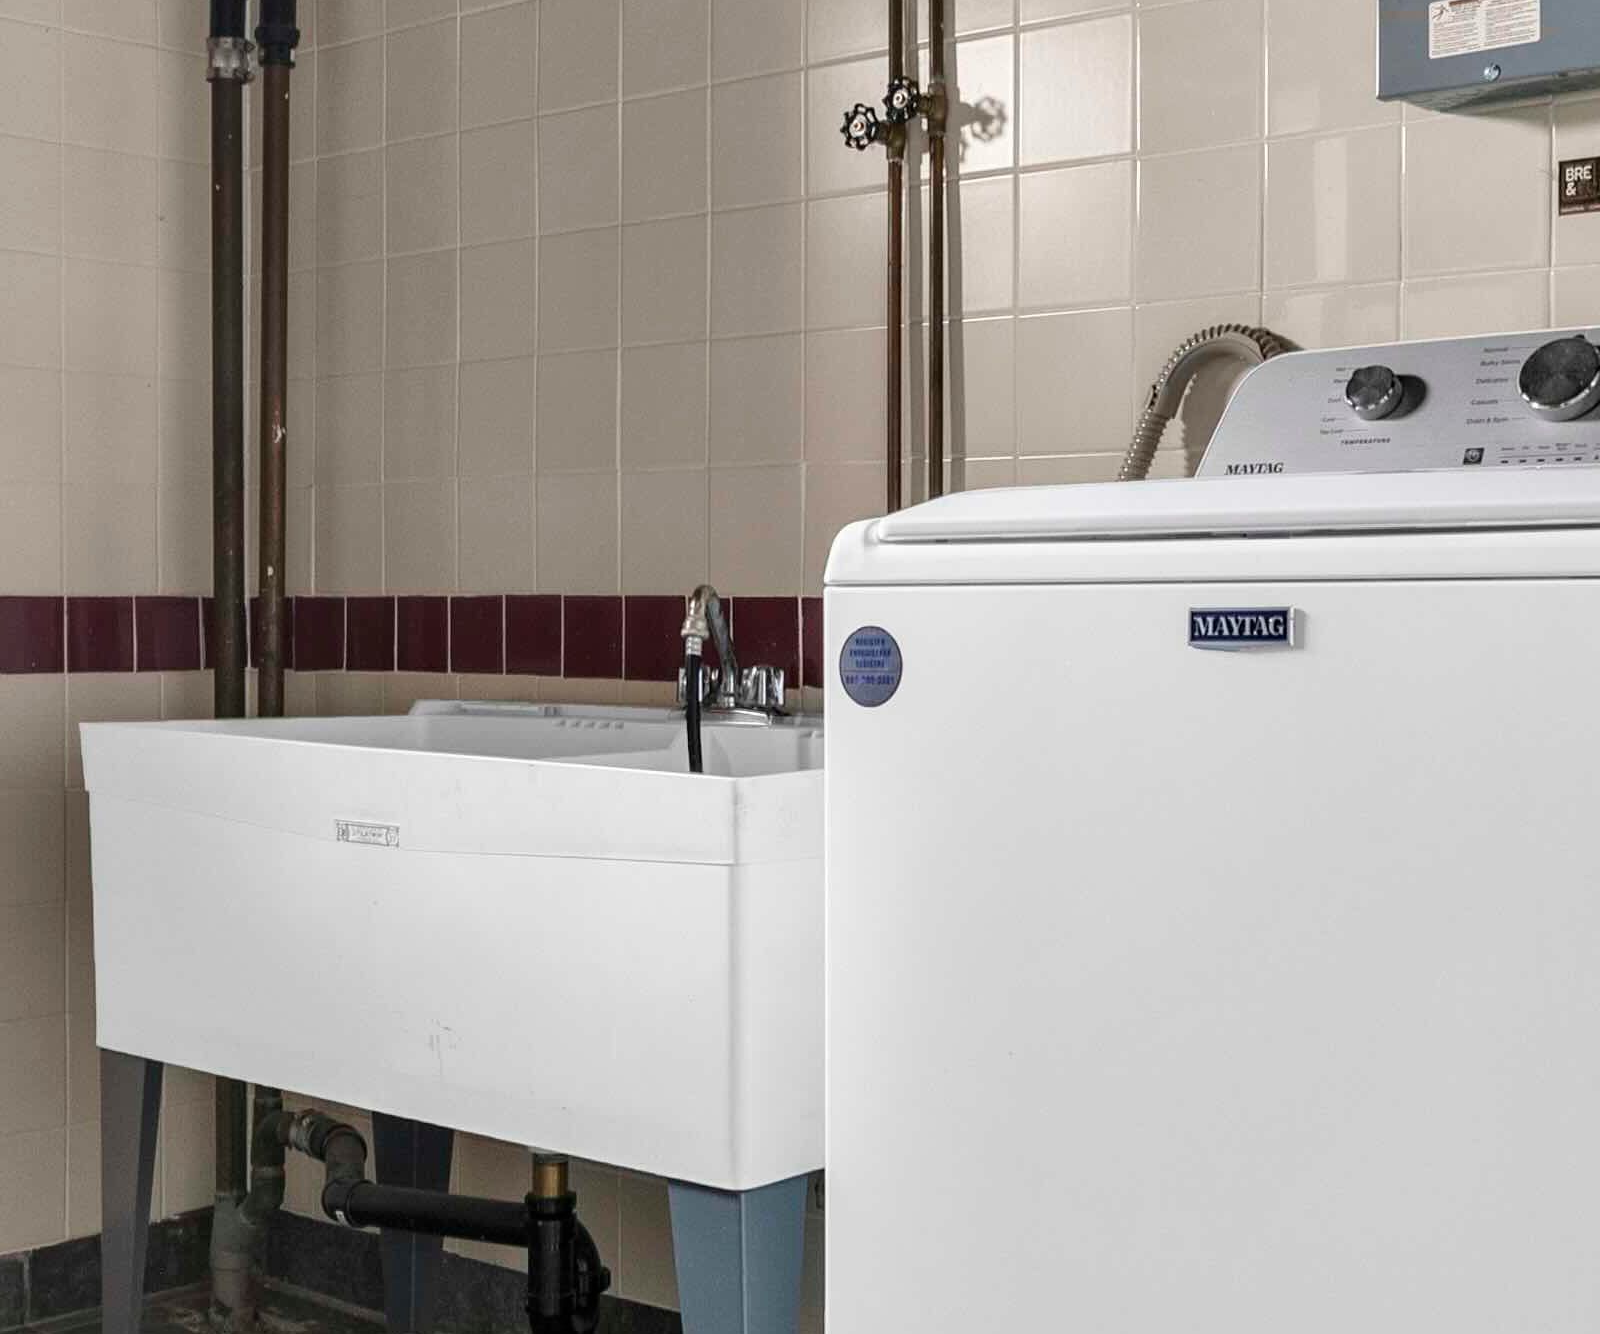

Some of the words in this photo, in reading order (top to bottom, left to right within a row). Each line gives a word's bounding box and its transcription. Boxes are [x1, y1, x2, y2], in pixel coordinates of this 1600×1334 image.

[1566, 165, 1592, 182] BRE
[1566, 182, 1577, 196] &
[1224, 461, 1285, 476] MAYTAG
[1193, 615, 1285, 636] MAYTAG
